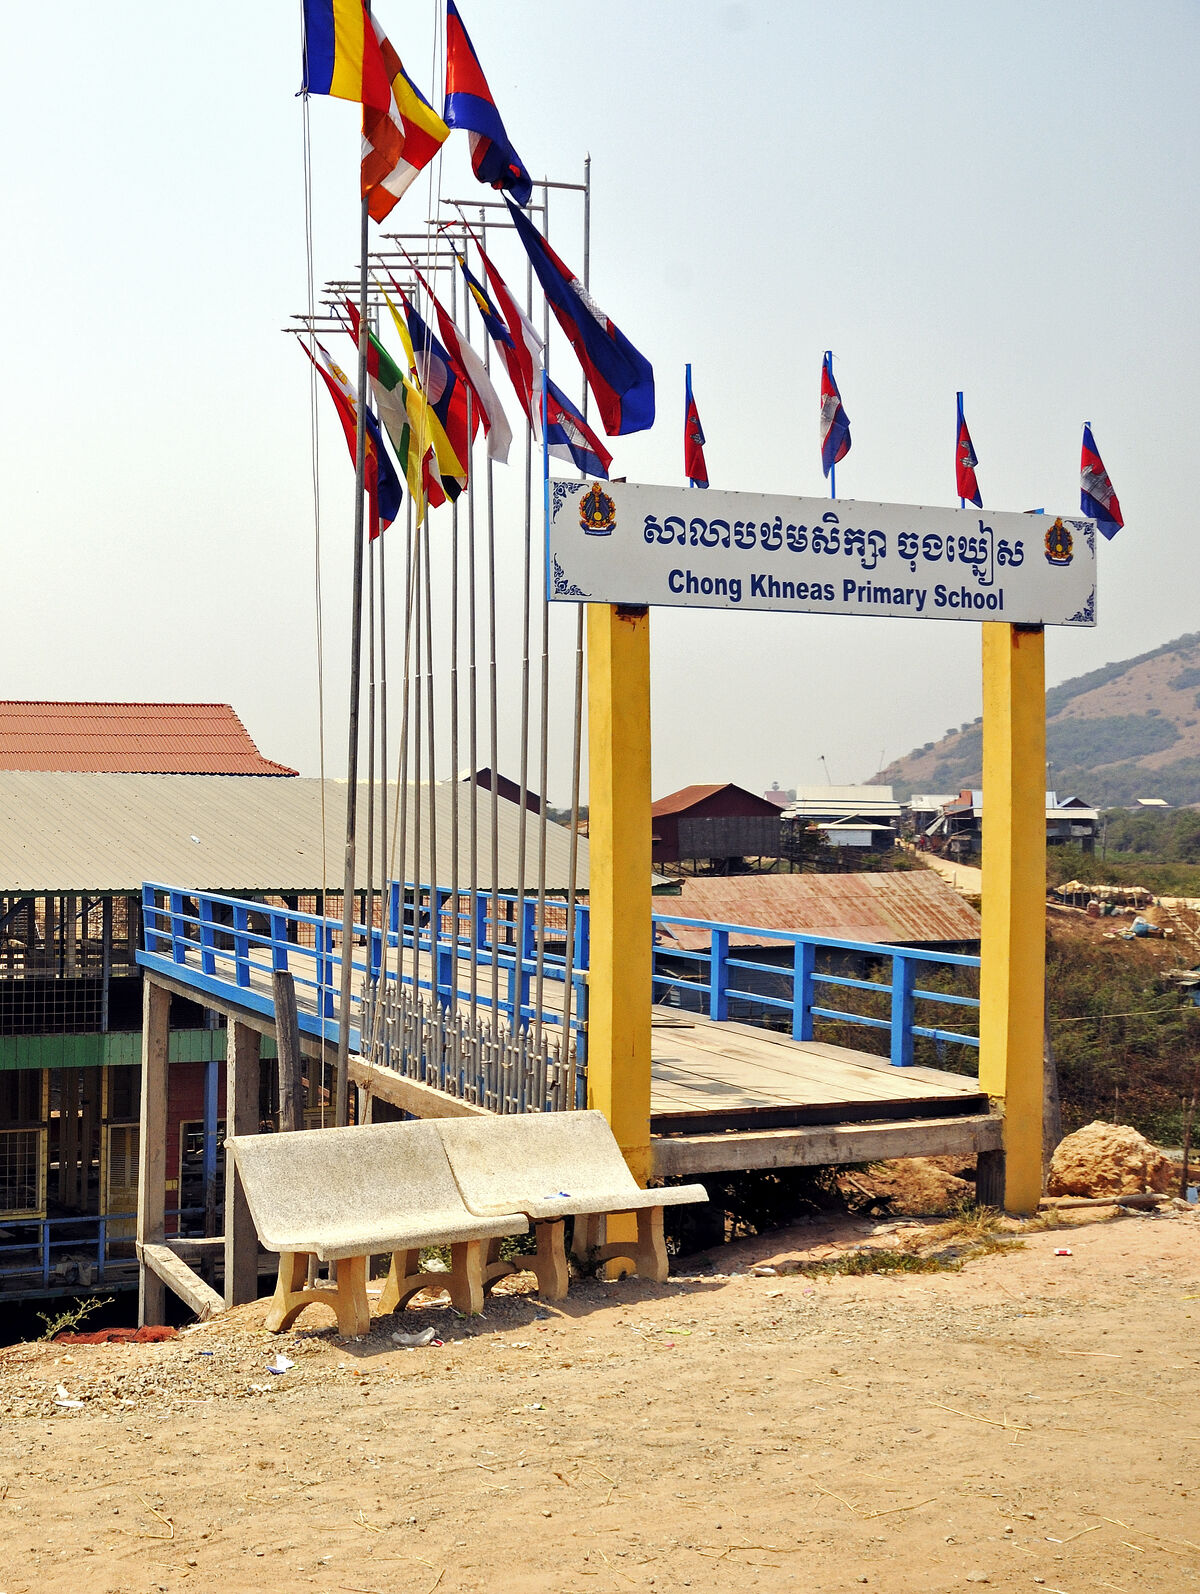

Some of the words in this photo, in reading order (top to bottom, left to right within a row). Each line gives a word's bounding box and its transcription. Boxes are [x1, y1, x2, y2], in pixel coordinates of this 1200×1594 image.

[643, 511, 887, 570] សាលាបឋមសិក្សា
[668, 569, 742, 603] Chong
[750, 573, 836, 602] Khneas
[842, 578, 928, 612] Primary
[933, 584, 1004, 611] School
